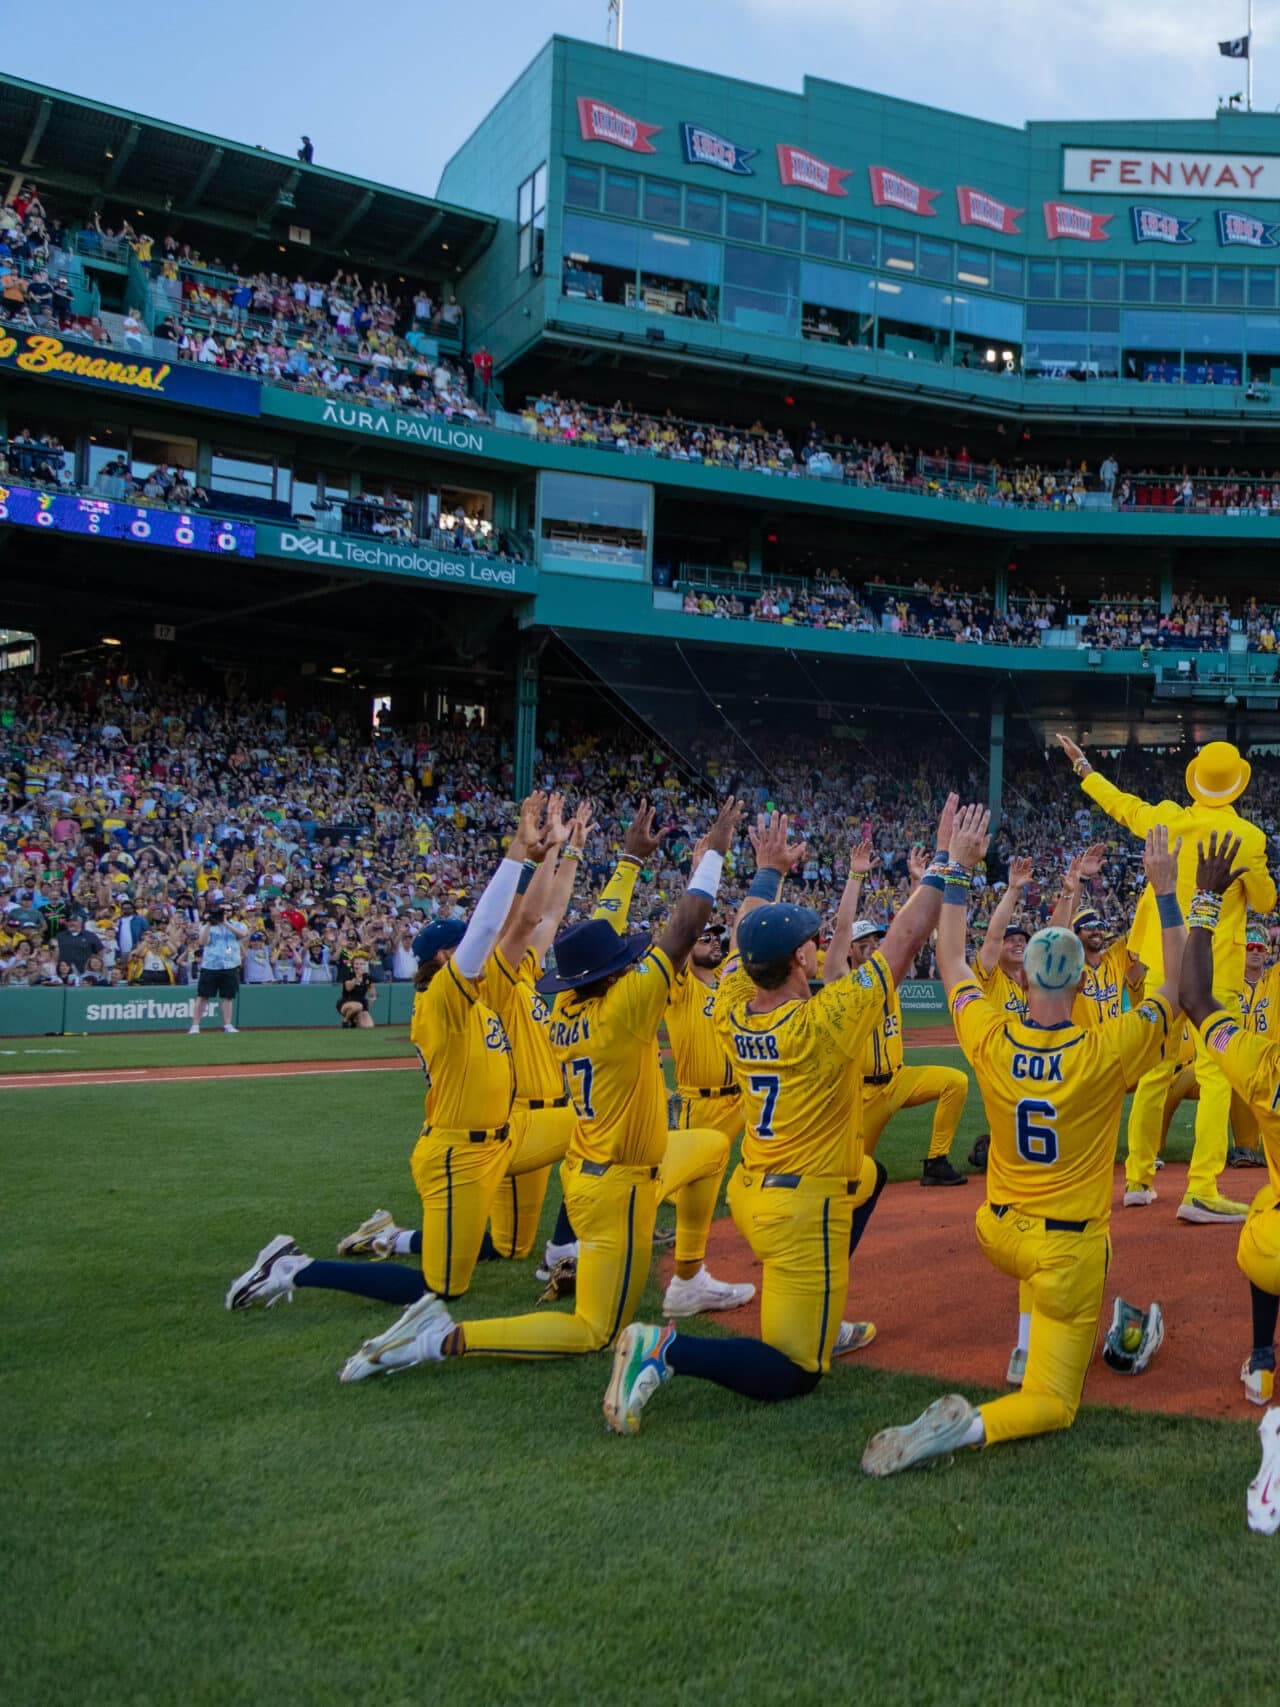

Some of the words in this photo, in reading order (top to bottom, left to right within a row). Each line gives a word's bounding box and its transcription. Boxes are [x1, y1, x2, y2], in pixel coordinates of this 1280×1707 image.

[1090, 159, 1264, 189] FENWAY
[0, 327, 17, 358] o
[16, 335, 171, 392] Bananas!
[396, 419, 484, 452] PAVILION
[280, 532, 344, 560] DELL
[342, 541, 465, 578] Technologies
[470, 560, 516, 585] Level
[734, 1034, 779, 1060] DEEB
[1011, 1052, 1063, 1082] COX
[749, 1074, 780, 1138] 7
[1015, 1097, 1059, 1167] 6
